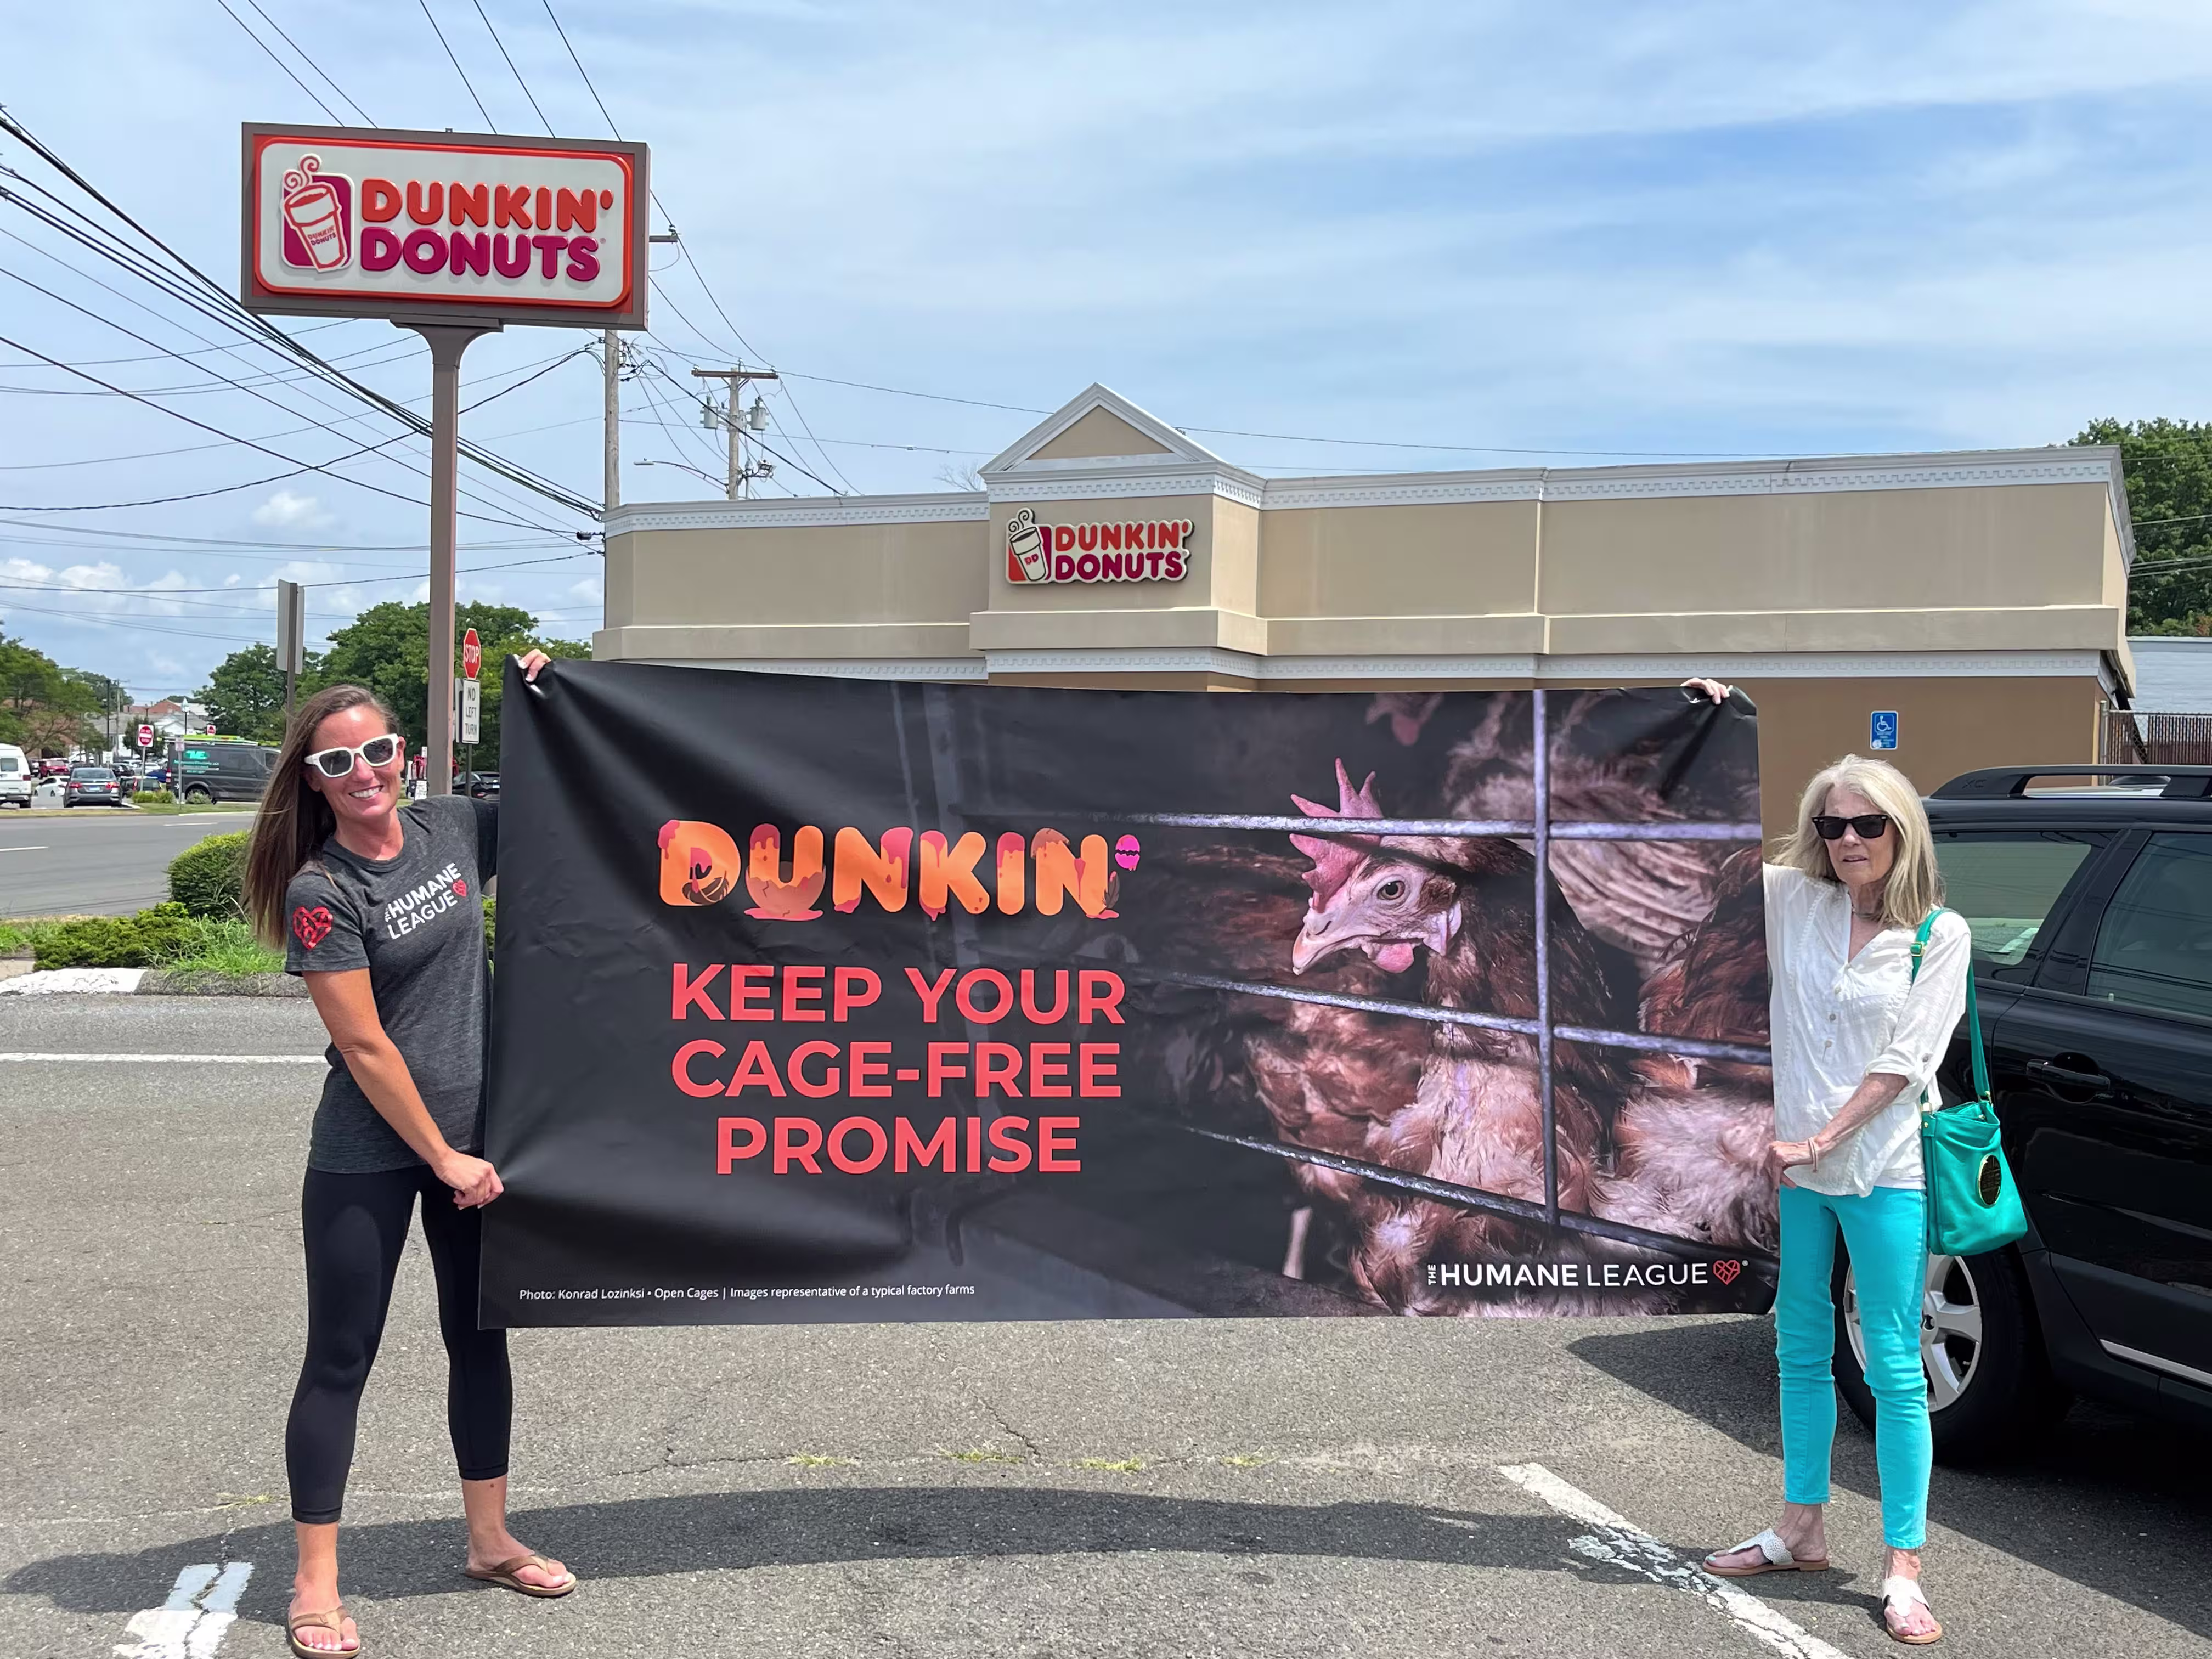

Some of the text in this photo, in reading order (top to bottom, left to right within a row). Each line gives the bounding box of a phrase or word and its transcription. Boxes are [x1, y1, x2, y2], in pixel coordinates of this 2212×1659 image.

[361, 178, 614, 232] DUNKIN'
[360, 225, 600, 281] DONUTS
[1055, 522, 1189, 552] DUNKIN'
[1024, 553, 1039, 565] DD
[1055, 551, 1183, 580] DONUTS
[465, 644, 479, 664] STOP
[467, 686, 476, 701] NO
[465, 706, 477, 718] LEFT
[465, 723, 478, 735] TURN
[657, 819, 1141, 921] DUNKIN'
[388, 862, 462, 918] HUMANE
[387, 889, 458, 940] LEAGUE
[672, 963, 1125, 1025] KEEP YOUR
[672, 1039, 1121, 1098] CAGE-FREE
[717, 1116, 1081, 1175] PROMISE
[1427, 1263, 1708, 1286] THE HUMANE LEAGUE
[519, 1284, 975, 1300] Photo: Konrad Lozinksi Open Cages Images representative of a typical factory farms
